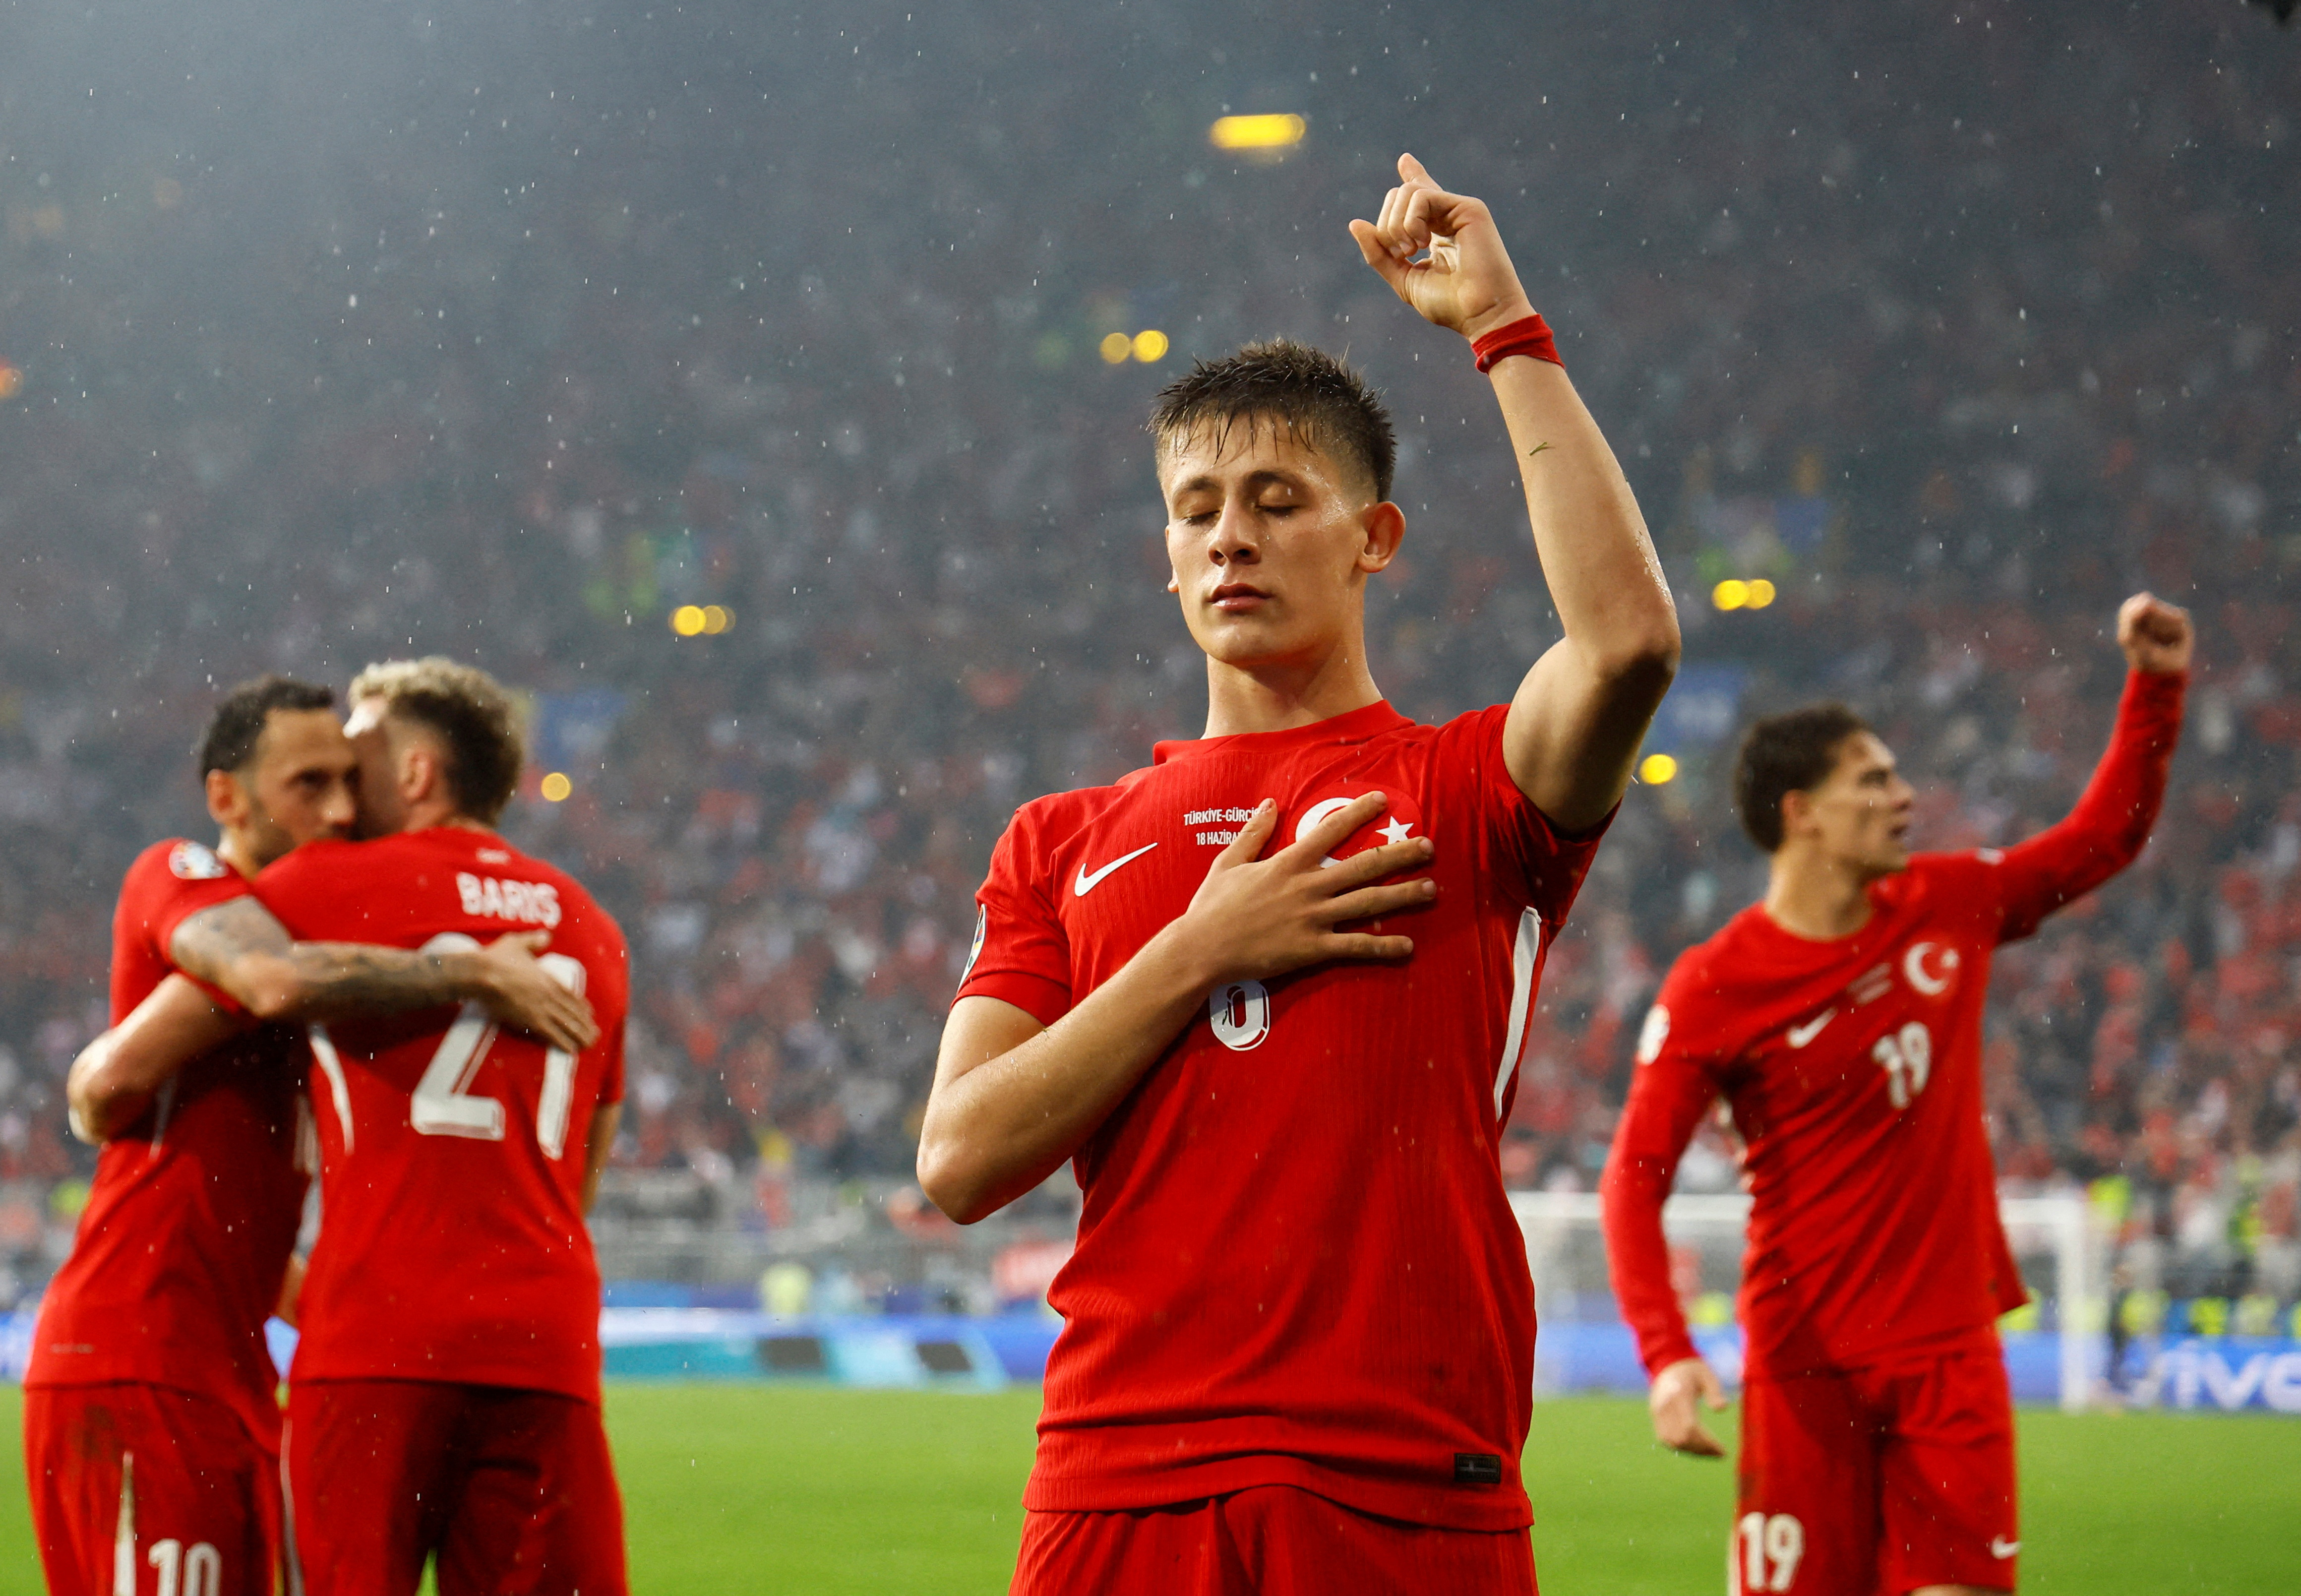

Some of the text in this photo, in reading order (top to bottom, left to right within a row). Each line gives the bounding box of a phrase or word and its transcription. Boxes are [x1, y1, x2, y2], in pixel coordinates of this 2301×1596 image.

[1196, 829, 1241, 845] 18 HAZİRA
[411, 931, 587, 1161] 21
[1871, 1021, 1931, 1109] 19
[148, 1537, 222, 1596] 10
[1739, 1511, 1806, 1594] 19
